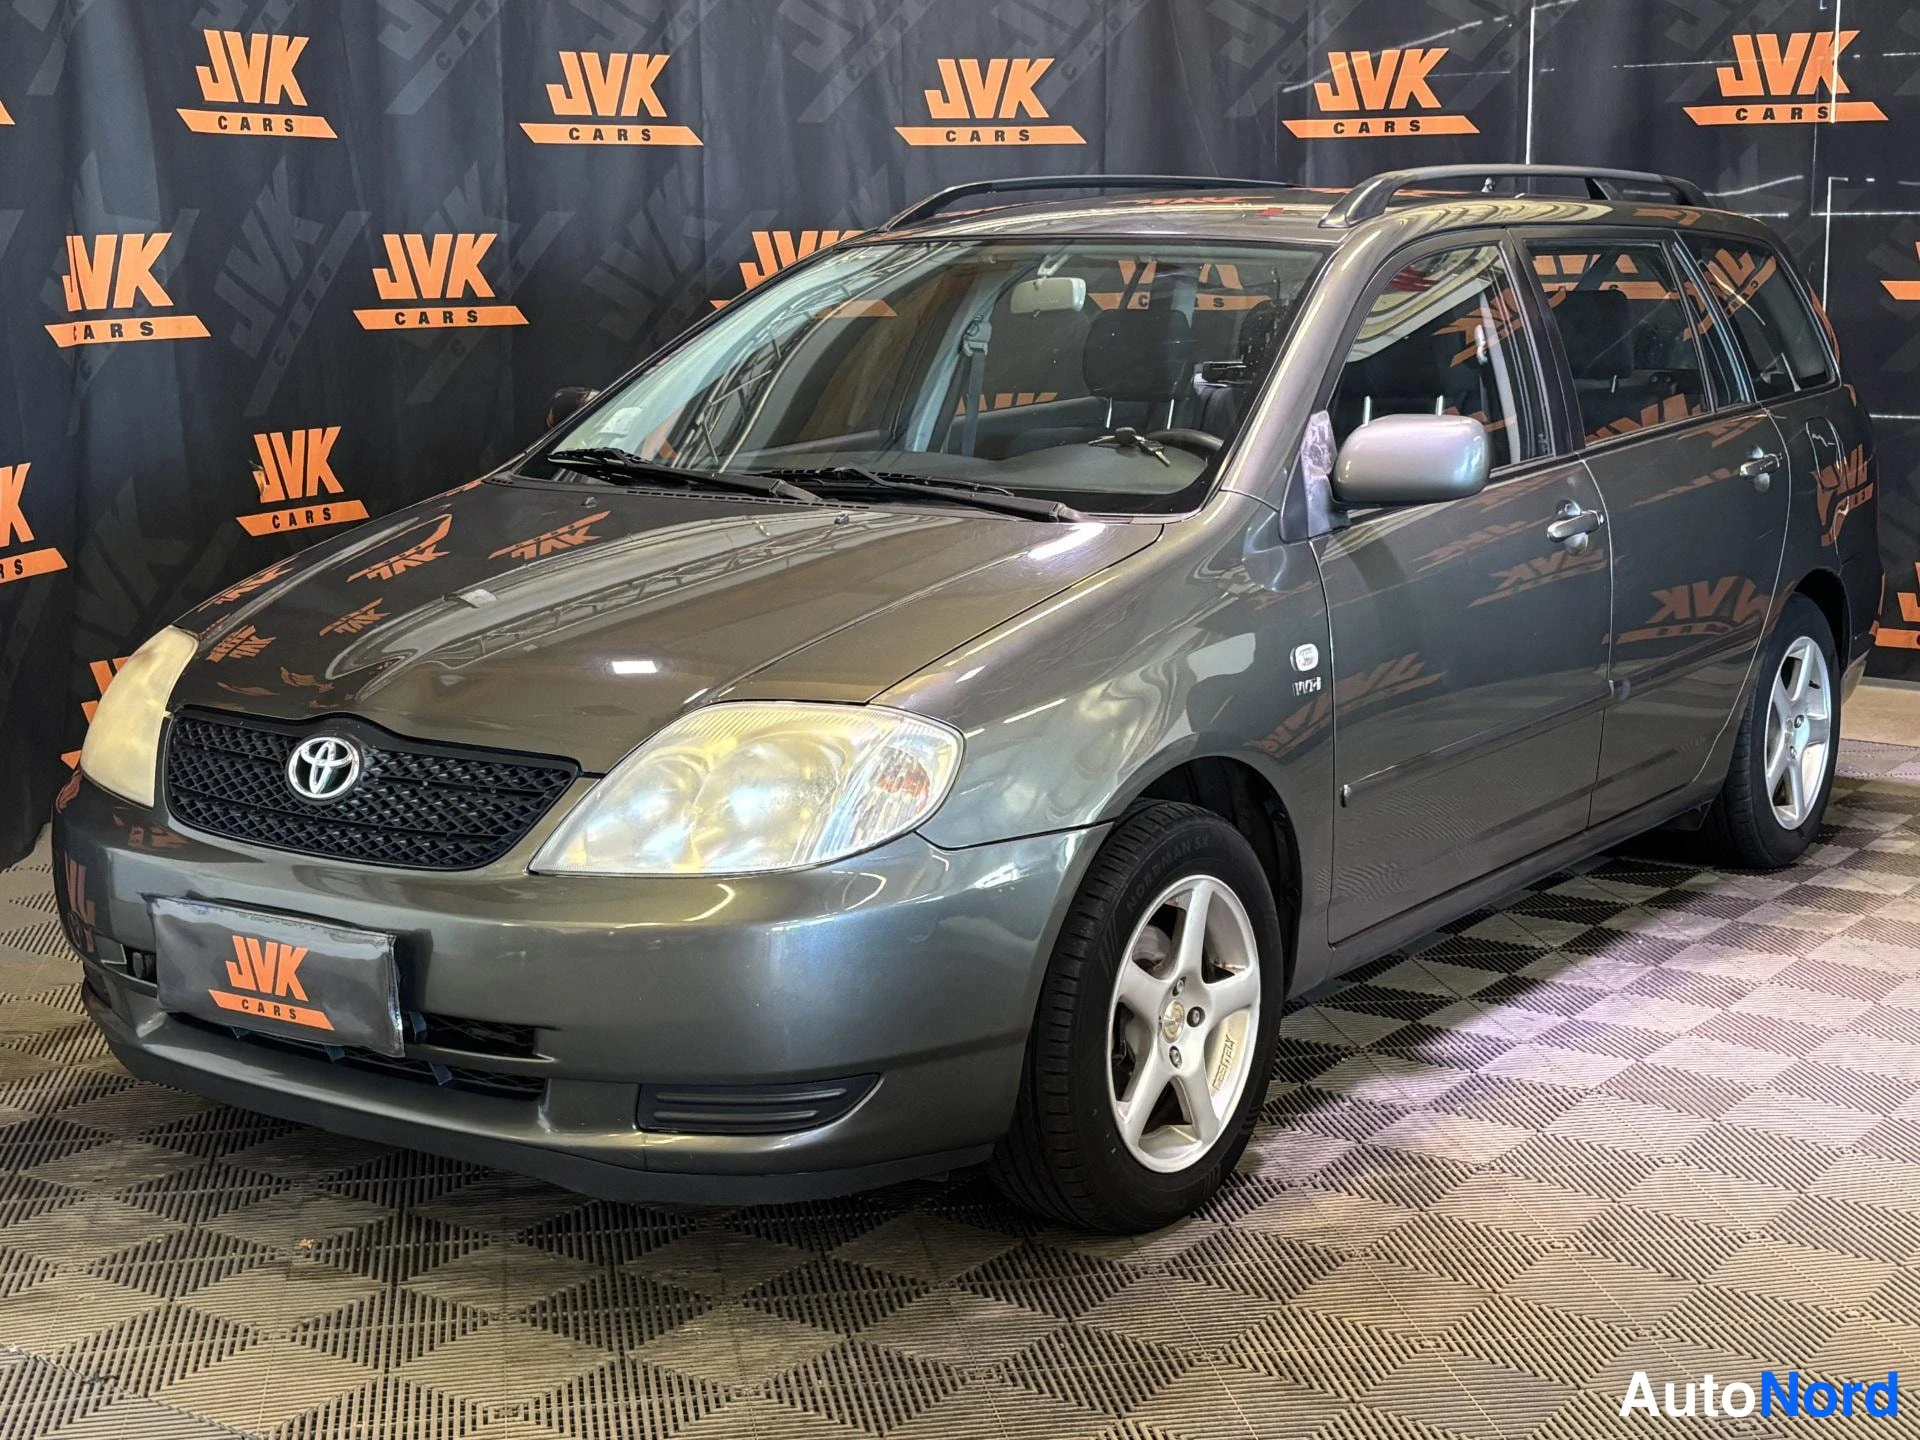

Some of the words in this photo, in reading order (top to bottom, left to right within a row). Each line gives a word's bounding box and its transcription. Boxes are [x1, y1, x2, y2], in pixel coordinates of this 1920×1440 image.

[195, 29, 310, 106] JVK
[546, 51, 670, 118] JVK
[1313, 47, 1449, 111] JVK
[1715, 30, 1860, 97] JVK
[923, 58, 1055, 119] JVK
[217, 115, 295, 134] CARS
[568, 127, 652, 142] CARS
[1333, 119, 1421, 135] CARS
[1735, 105, 1830, 122] CARS
[945, 129, 1031, 143] CARS
[62, 232, 174, 312] JVK
[371, 233, 498, 300] JVK
[73, 321, 154, 342] ARS
[394, 309, 479, 326] CARS
[252, 425, 345, 504] JVK
[271, 507, 332, 530] CARS
[225, 935, 309, 1001] JVK
[241, 999, 297, 1020] CARS
